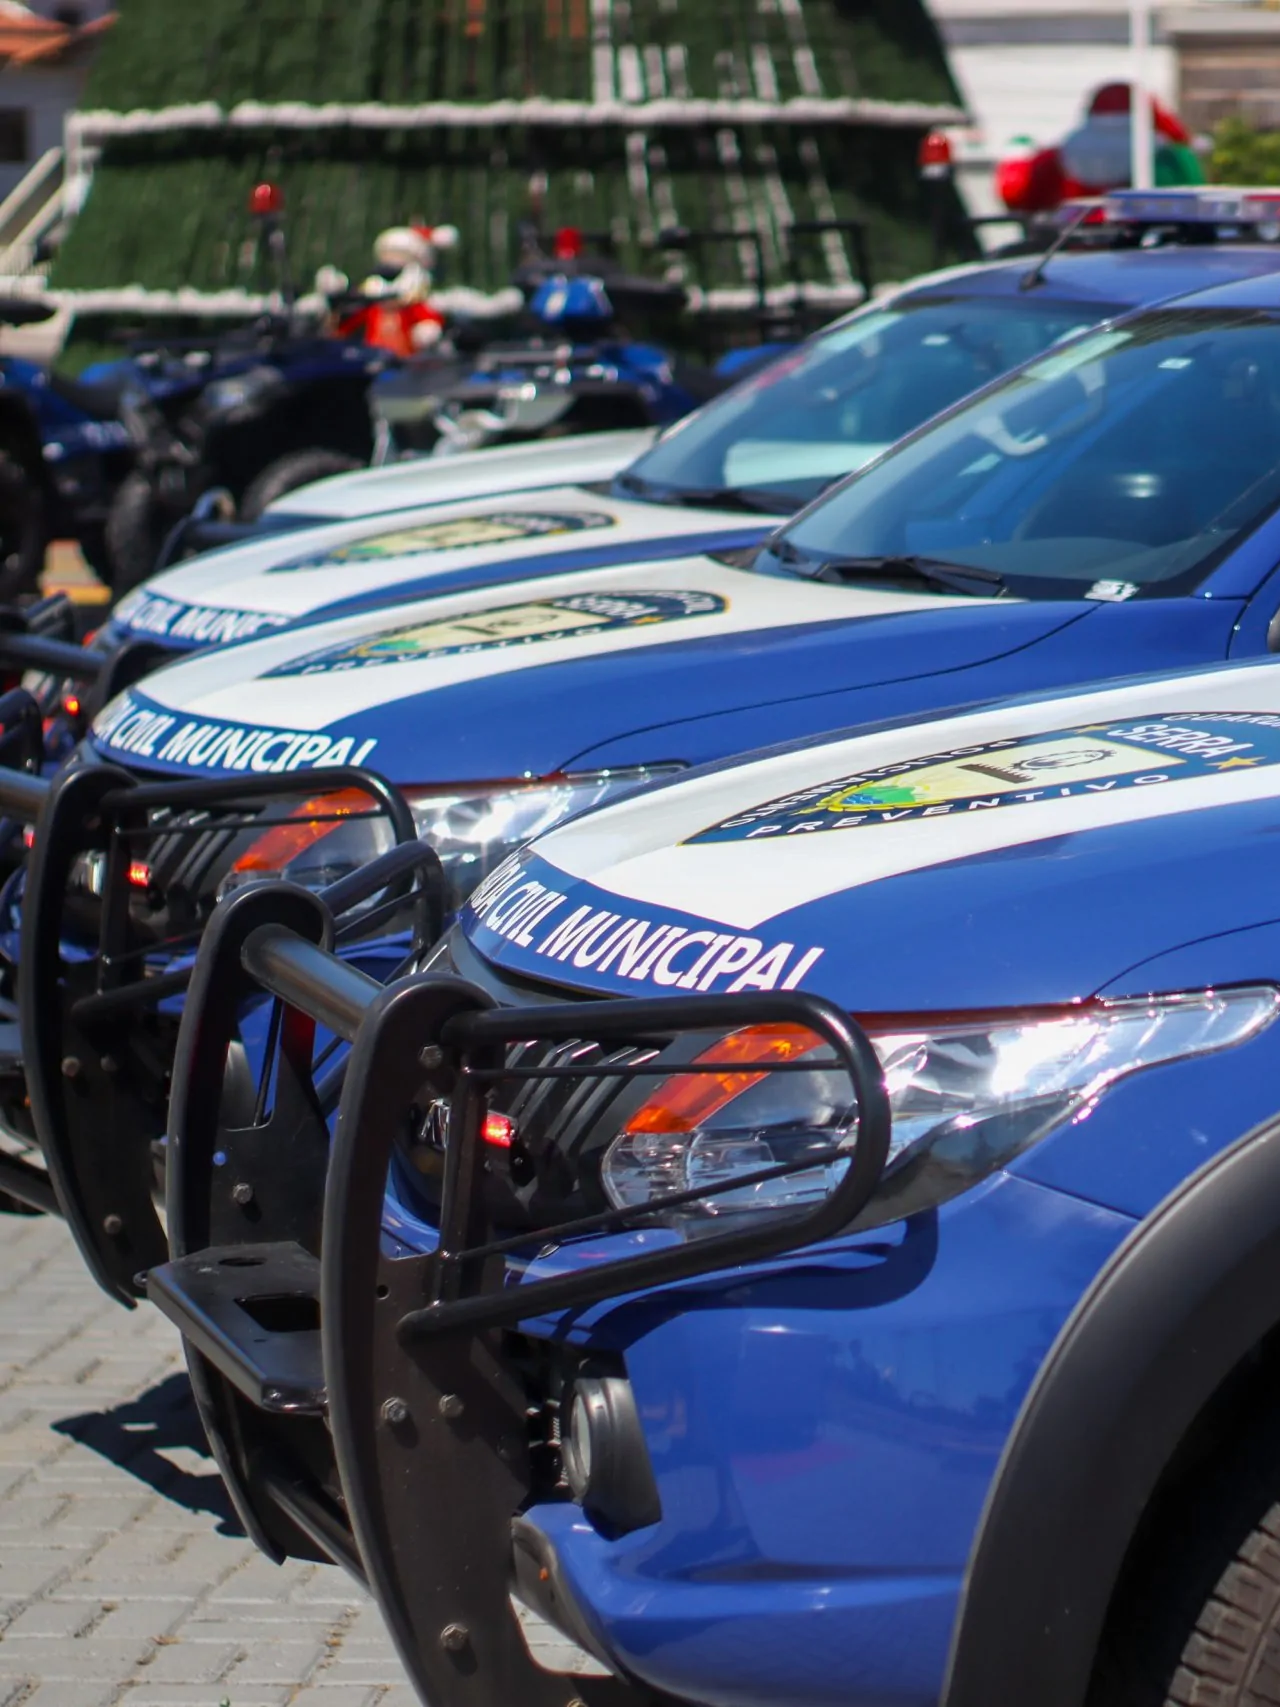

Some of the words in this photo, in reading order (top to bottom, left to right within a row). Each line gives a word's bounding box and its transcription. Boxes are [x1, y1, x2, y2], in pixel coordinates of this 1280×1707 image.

[110, 709, 176, 758] CIVIL
[1106, 724, 1254, 759] SERRA
[746, 774, 1169, 838] PREVENTIVO
[486, 881, 568, 948] CIVIL
